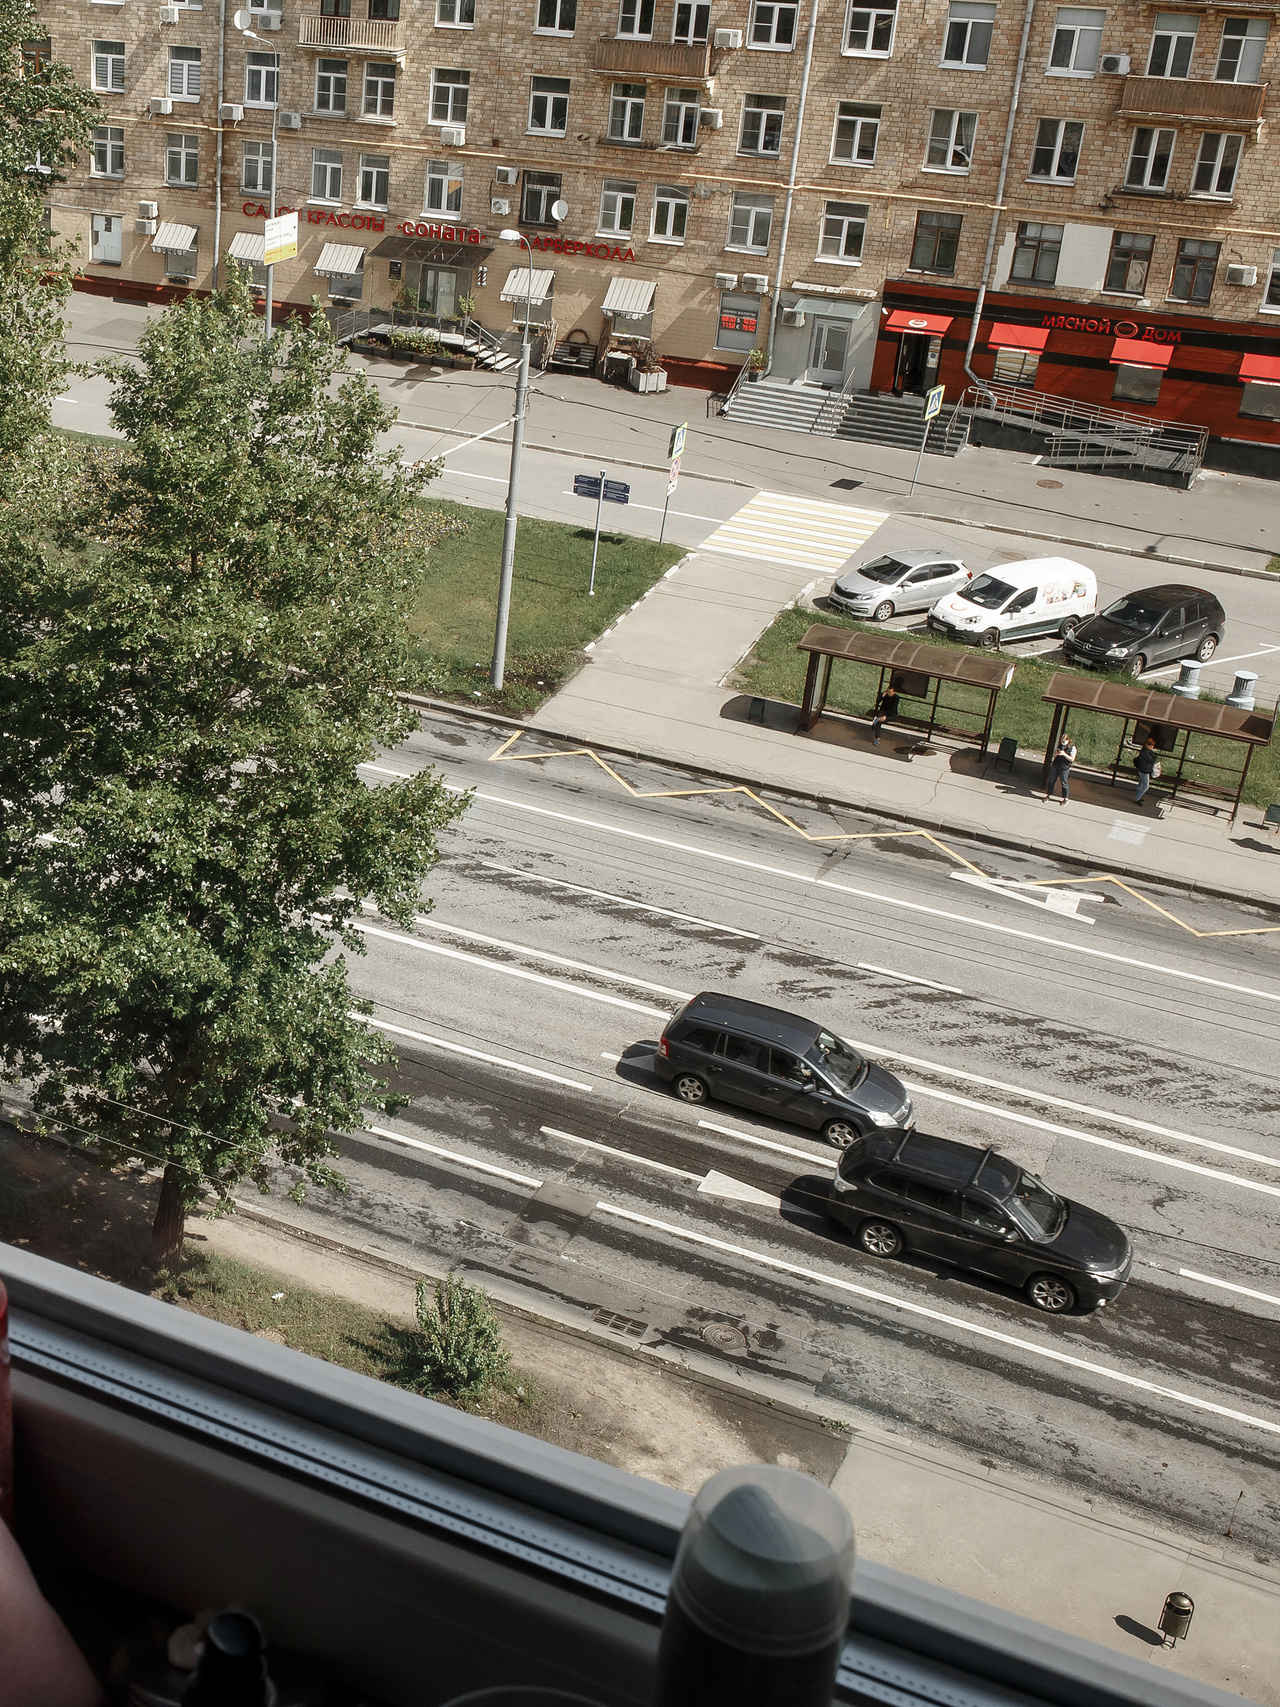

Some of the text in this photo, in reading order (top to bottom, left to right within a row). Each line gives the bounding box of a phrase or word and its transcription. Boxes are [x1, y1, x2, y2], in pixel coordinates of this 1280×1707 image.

[307, 209, 385, 232] КРАСОТЫ
[520, 234, 635, 262] БАРБЕРХОЛЛ
[1041, 314, 1181, 342] МЯСНОЙ ДОМ
